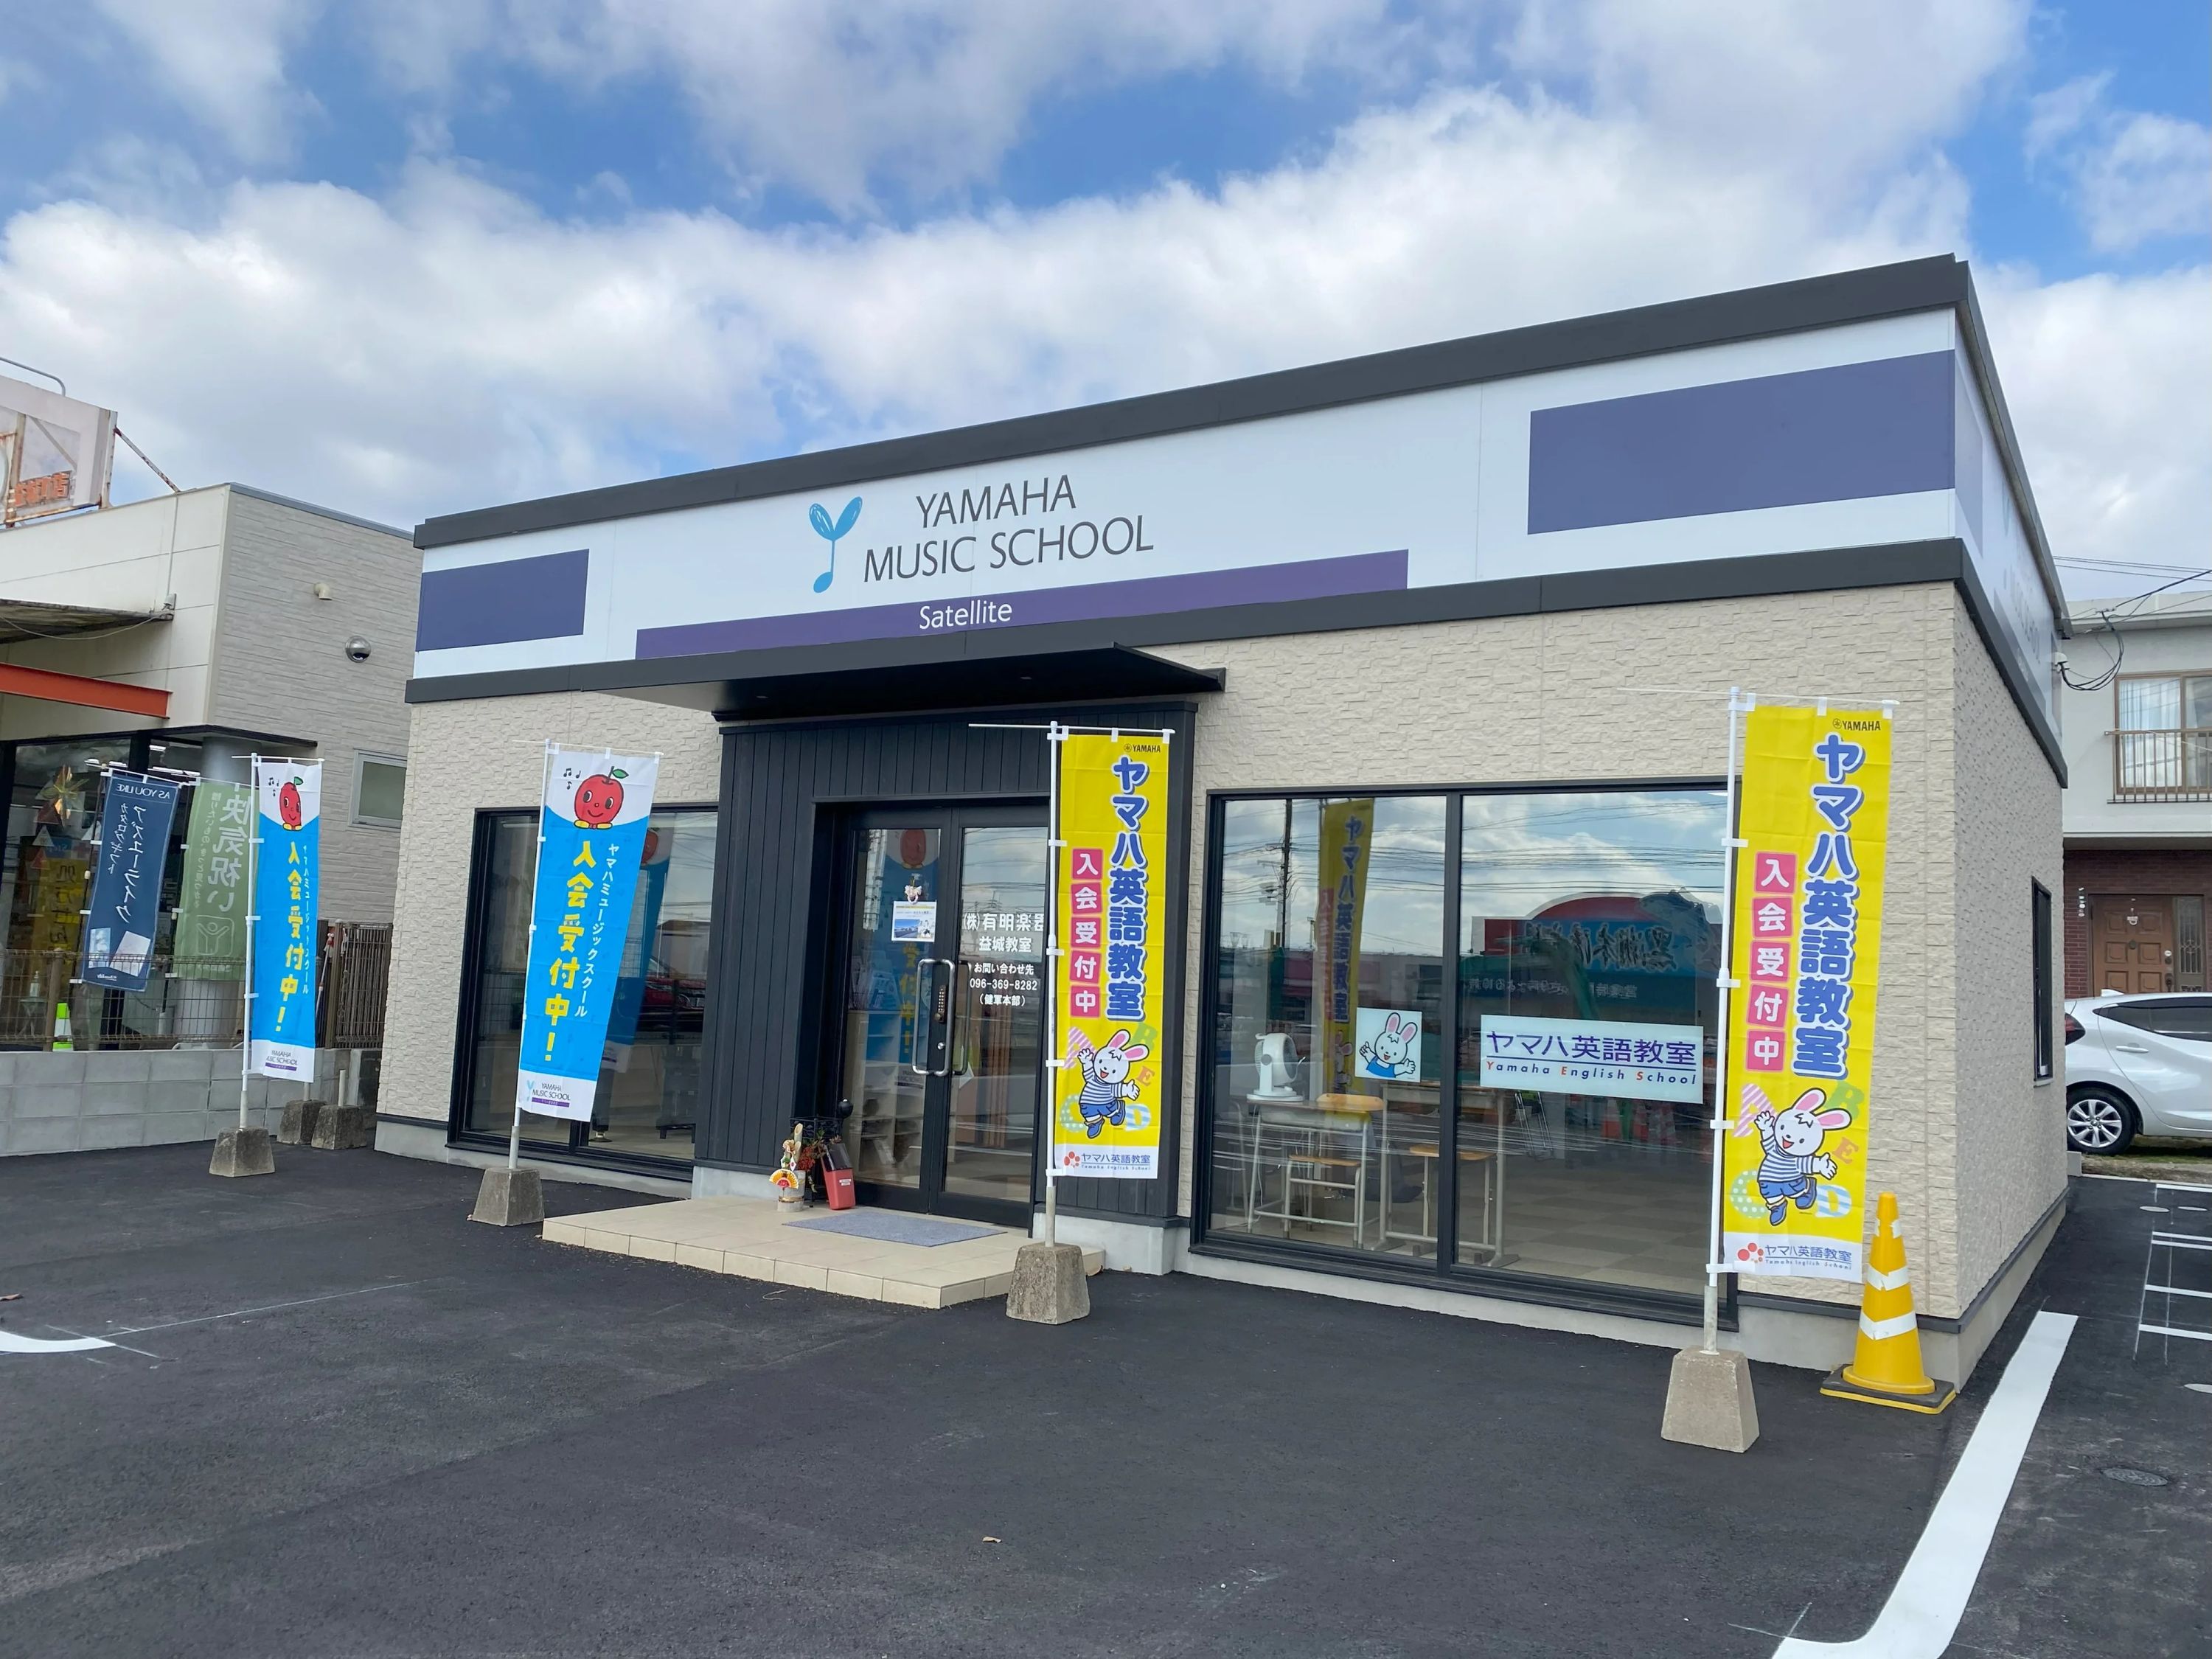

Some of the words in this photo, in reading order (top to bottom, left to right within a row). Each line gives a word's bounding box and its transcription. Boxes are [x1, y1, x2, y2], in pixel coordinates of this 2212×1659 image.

[916, 474, 1077, 529] YAMAHA
[863, 536, 976, 582] MUSIC
[990, 515, 1155, 569] SCHOOL
[919, 599, 1012, 630] Satellite
[1843, 720, 1881, 731] YAMAHA
[1132, 743, 1161, 753] YAMAHA
[1106, 754, 1150, 1021] ヤマハ英語教室
[1791, 732, 1865, 1079] ヤマハ英語教室
[574, 844, 620, 1018] ヤマハミュージックスクール
[1074, 853, 1099, 1013] 入会受付中
[979, 936, 1032, 953] 益城教室
[974, 962, 1034, 975] お問い合わせ先
[1753, 858, 1790, 1066] 入会受付中
[970, 978, 1037, 990] 096-369-8282
[1486, 1031, 1696, 1065] ヤマハ英語教室
[1486, 1061, 1550, 1074] Yamaha
[1560, 1066, 1625, 1079] English
[1635, 1071, 1696, 1085] School
[532, 1089, 548, 1097] MUSIC
[549, 1091, 571, 1101] SCHOOL
[541, 1082, 562, 1091] YAMAHA
[1081, 1153, 1151, 1164] ヤマハ英語教室
[1764, 1245, 1852, 1262] ヤマハ英語教室
